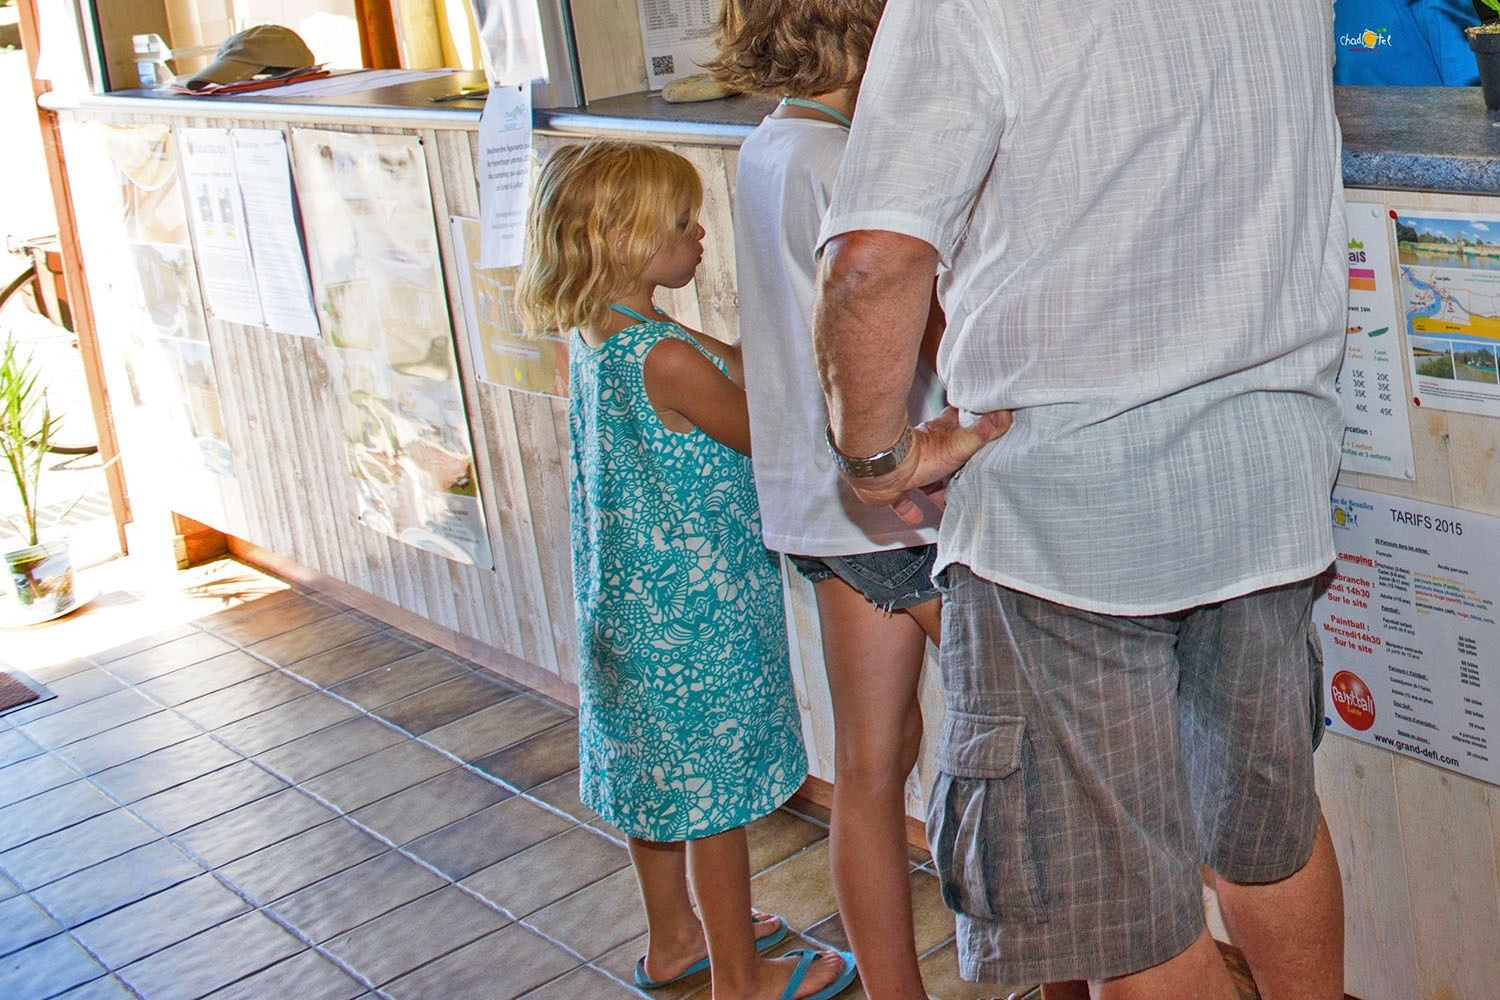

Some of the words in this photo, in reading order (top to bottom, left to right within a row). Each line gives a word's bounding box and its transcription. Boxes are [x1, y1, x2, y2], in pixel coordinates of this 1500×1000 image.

[1390, 509, 1432, 529] TARIFS
[1435, 519, 1463, 535] 2015
[1338, 552, 1372, 567] camping
[1328, 593, 1341, 601] Sur
[1343, 595, 1349, 603] le
[1352, 598, 1368, 608] site
[1331, 615, 1365, 631] Paintball
[1374, 733, 1459, 767] www.grand-defi.com
